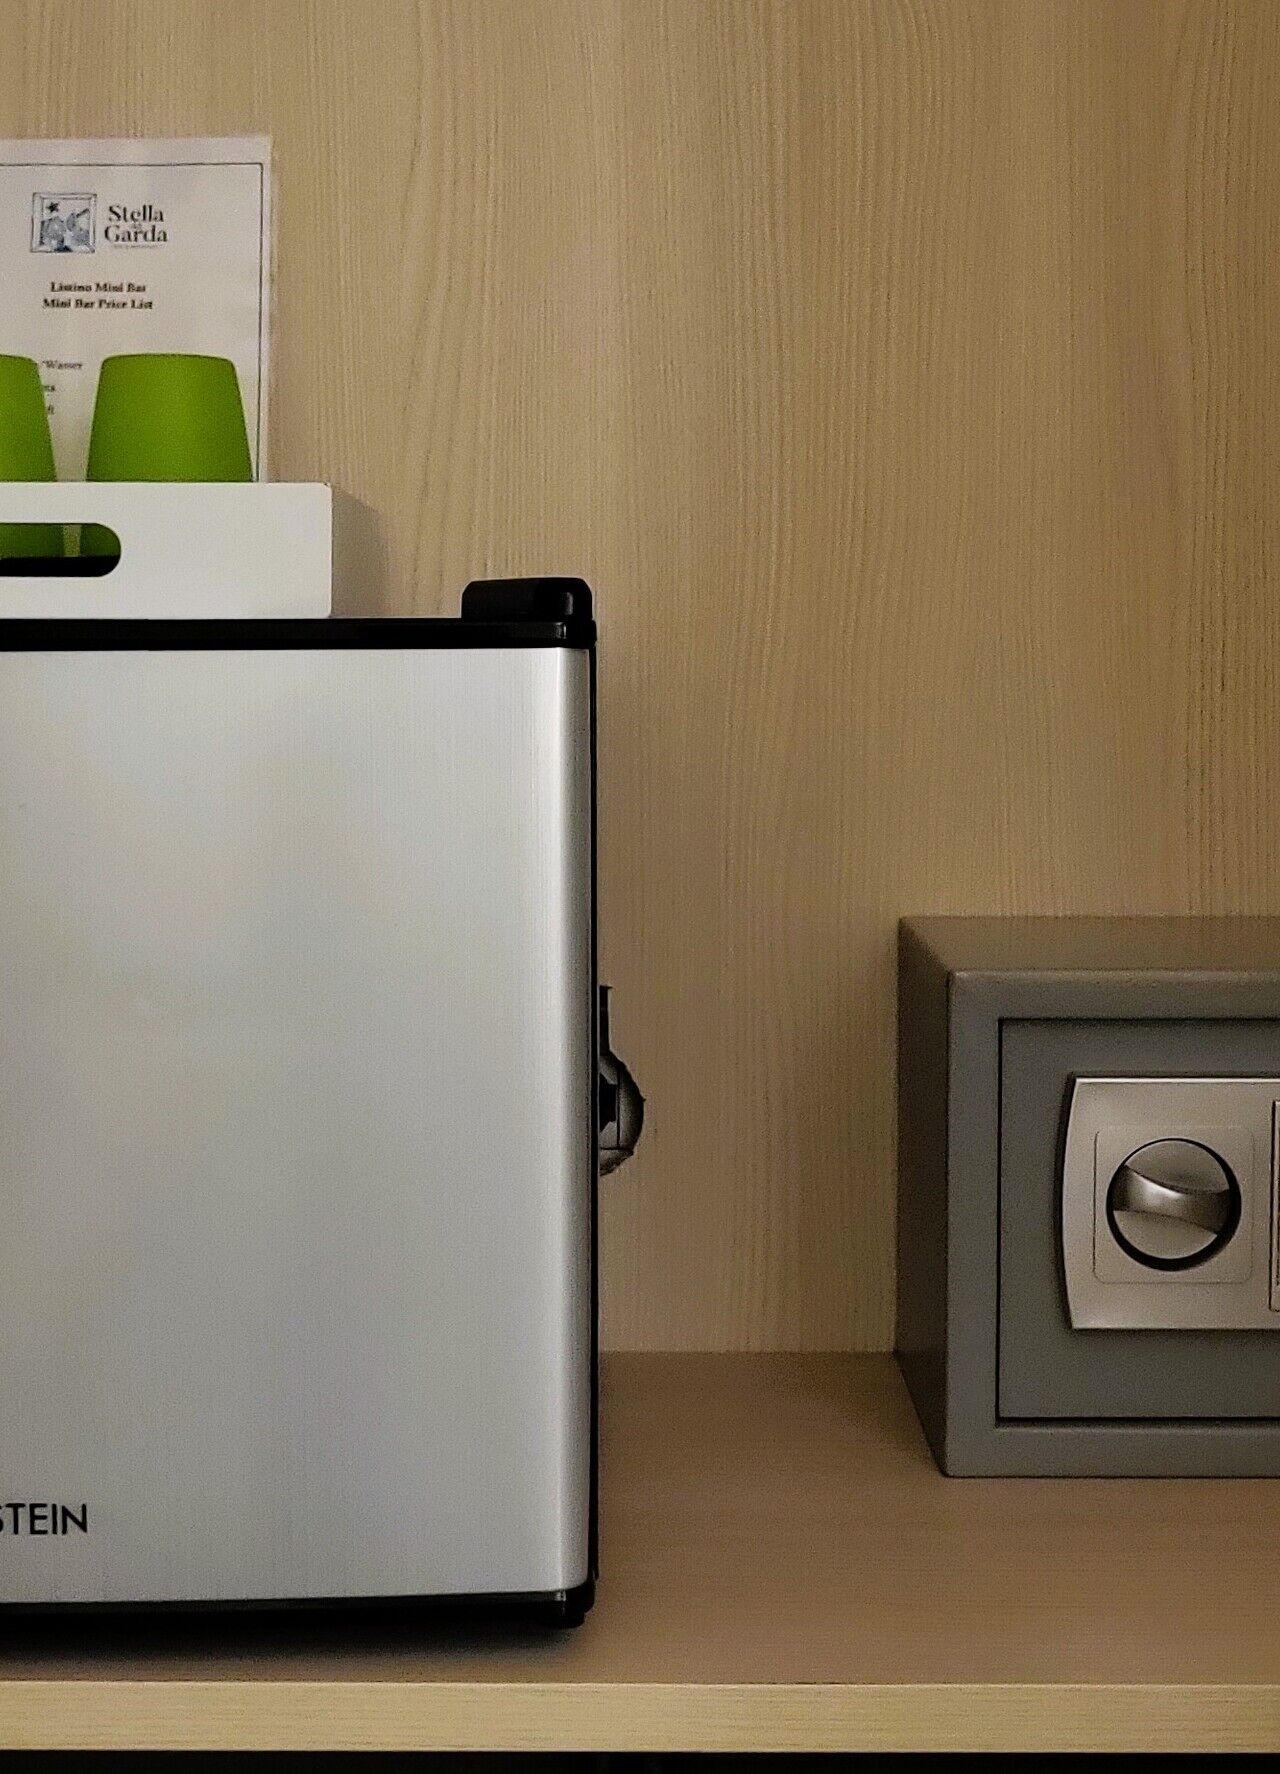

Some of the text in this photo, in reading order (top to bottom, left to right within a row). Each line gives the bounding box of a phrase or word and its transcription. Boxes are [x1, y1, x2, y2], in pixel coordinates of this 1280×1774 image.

[108, 204, 164, 222] Stella
[104, 224, 168, 242] Garda
[95, 282, 124, 293] Mini
[126, 282, 146, 293] Bar
[43, 298, 153, 310] Mini Bar Price List
